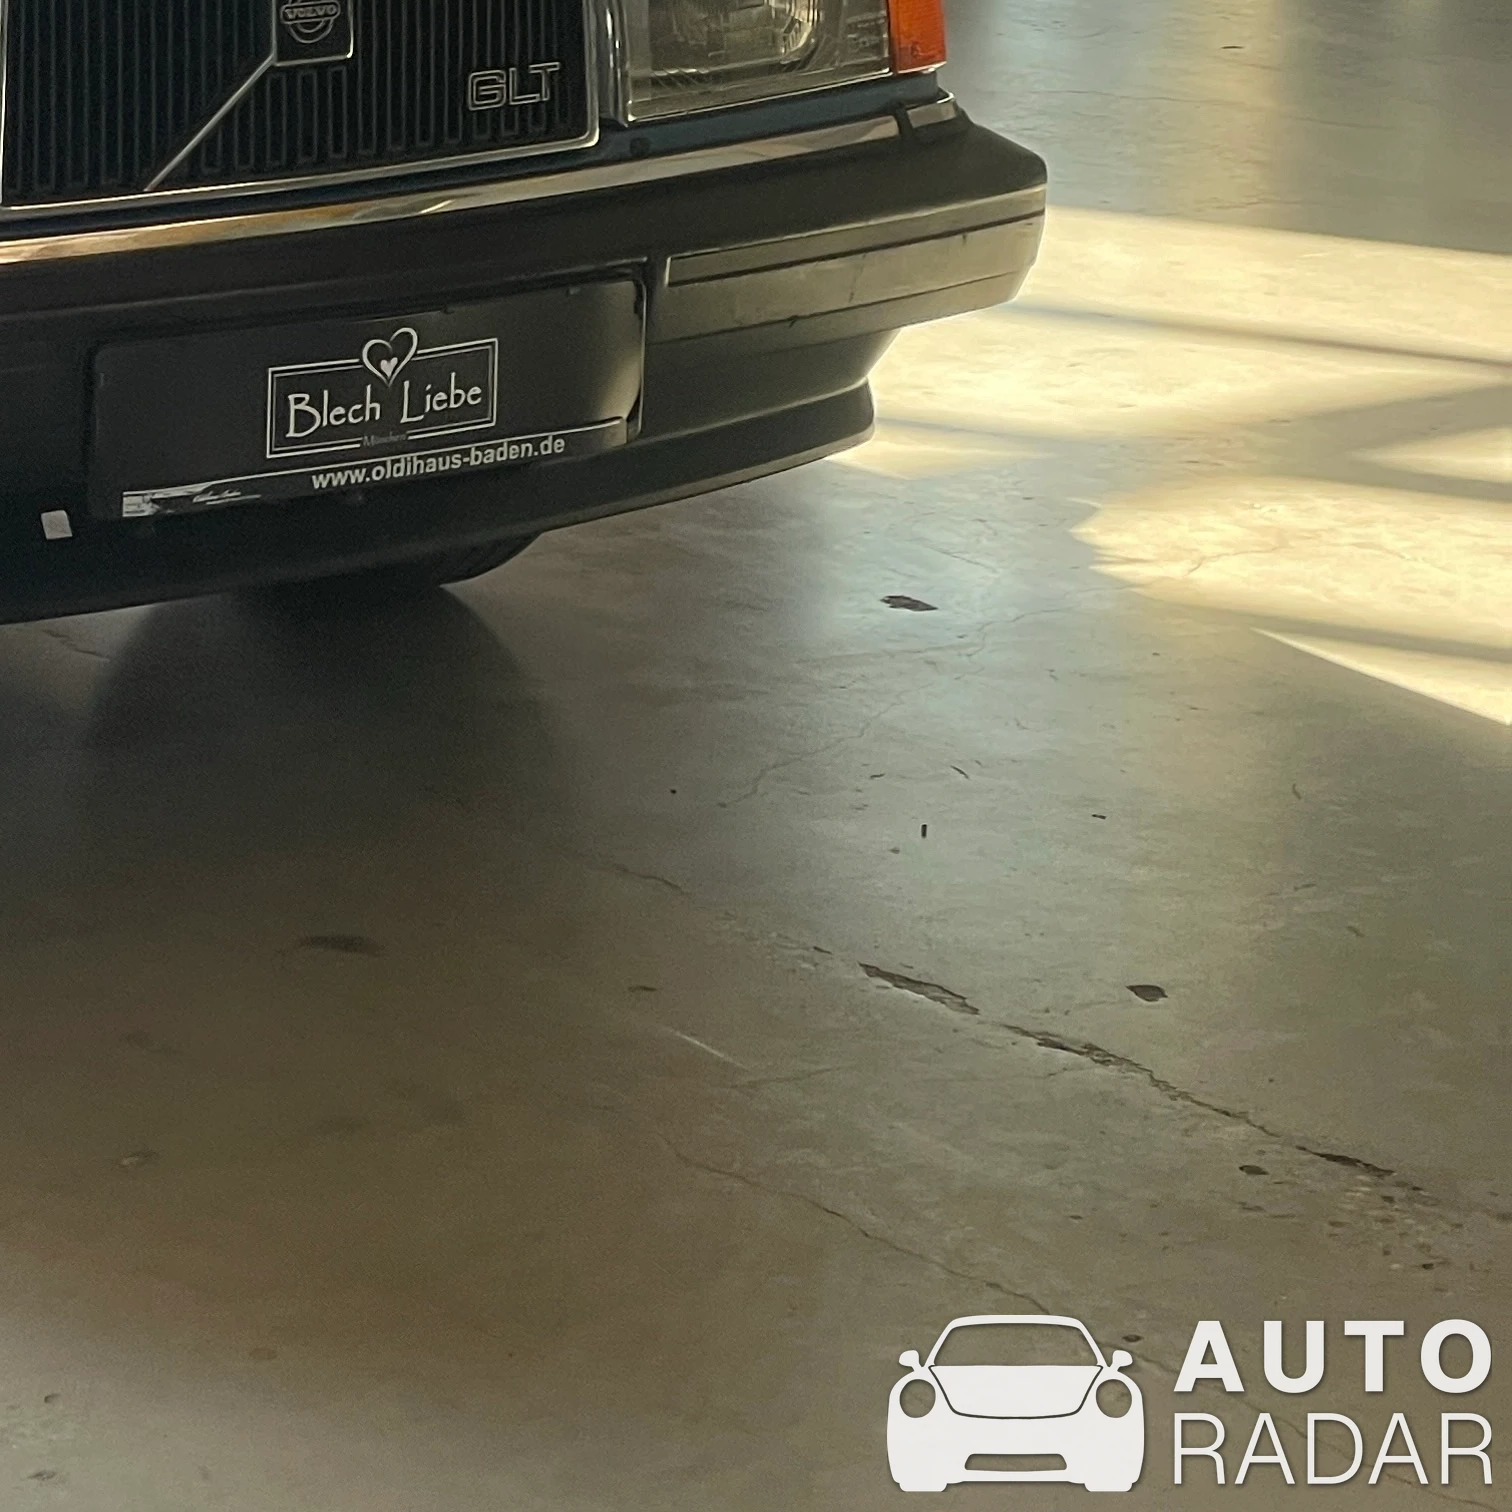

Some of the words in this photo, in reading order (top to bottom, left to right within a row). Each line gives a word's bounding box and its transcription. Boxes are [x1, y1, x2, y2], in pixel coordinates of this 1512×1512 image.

[284, 4, 337, 19] VOLVO
[468, 61, 561, 111] GLT
[285, 384, 381, 438] Blech
[400, 371, 482, 424] Liebe
[311, 435, 566, 489] www.oldihaus-baden.de
